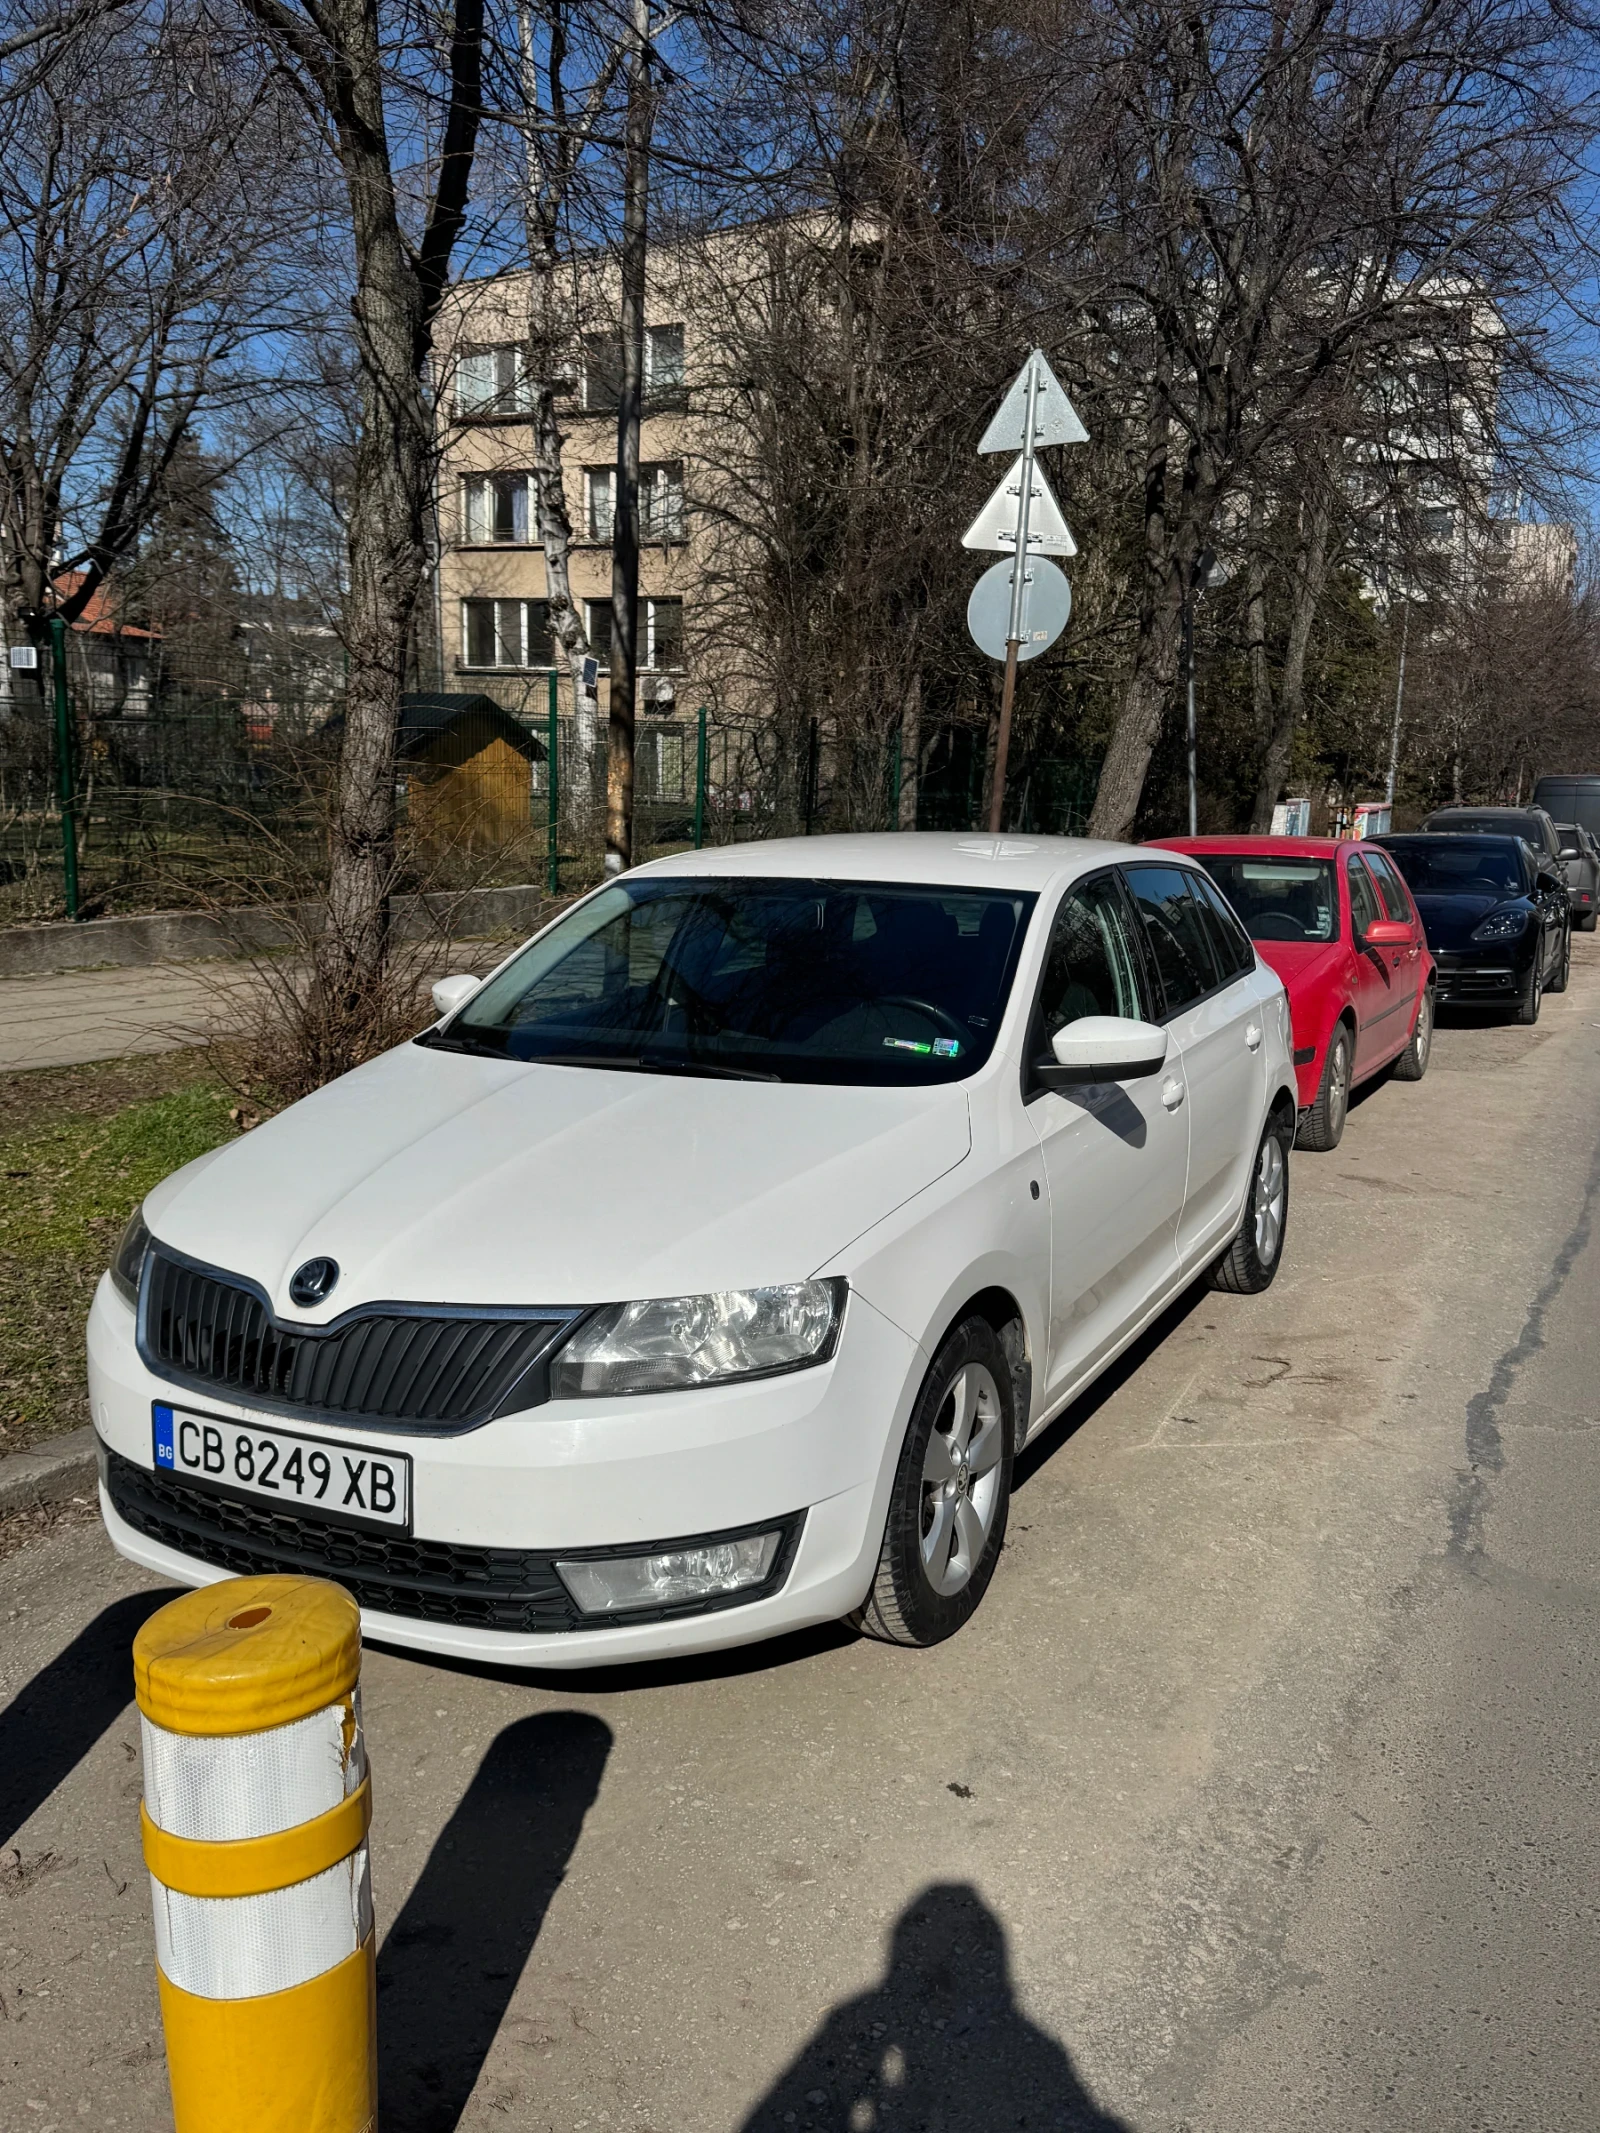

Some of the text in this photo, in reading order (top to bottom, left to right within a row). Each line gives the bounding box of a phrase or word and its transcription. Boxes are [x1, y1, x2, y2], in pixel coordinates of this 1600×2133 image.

[158, 1443, 172, 1459] BG
[179, 1420, 396, 1513] CB 8249 XB
